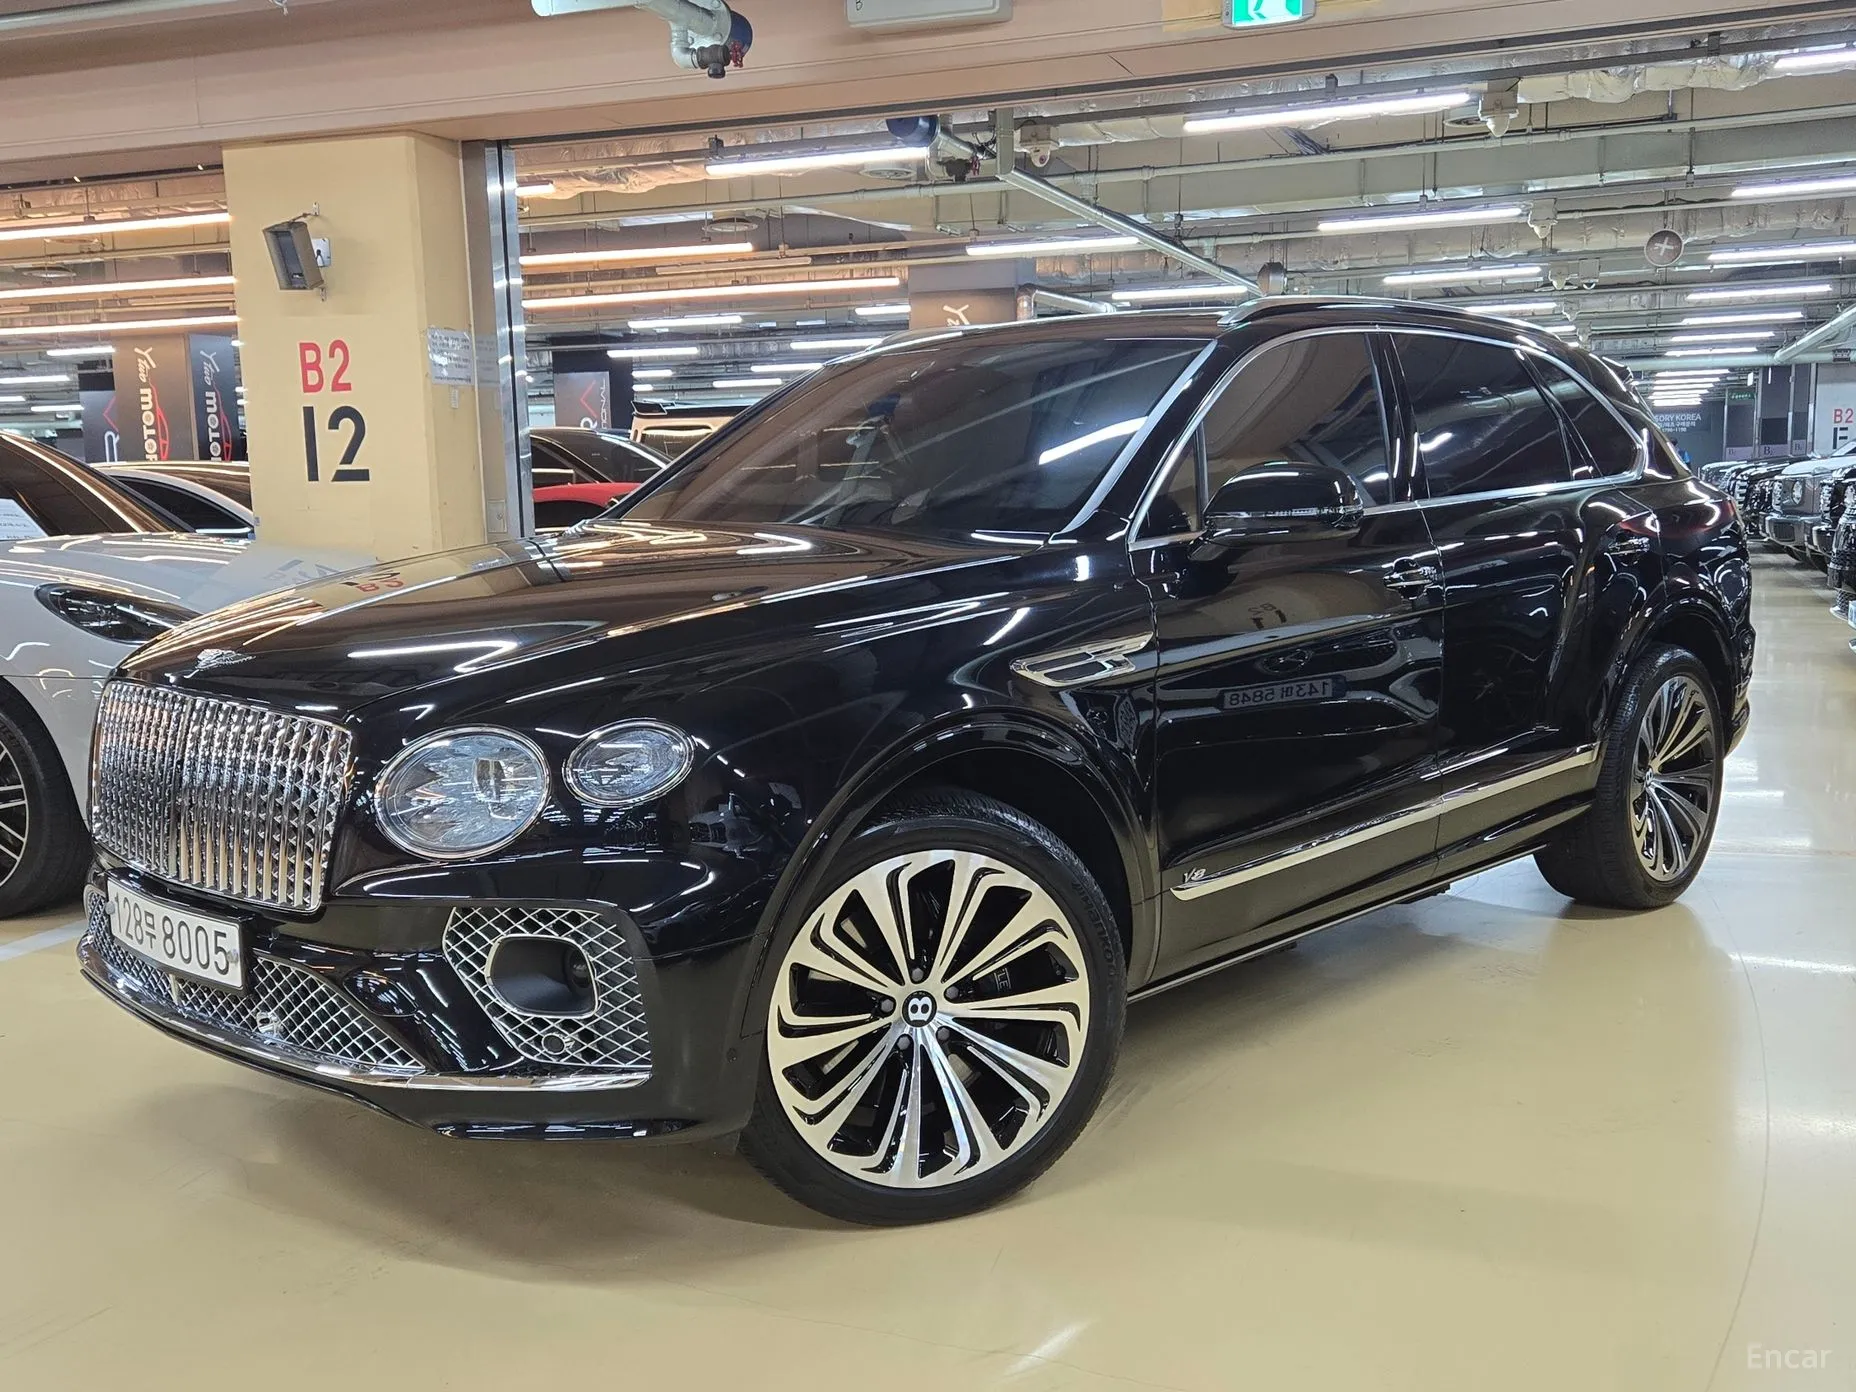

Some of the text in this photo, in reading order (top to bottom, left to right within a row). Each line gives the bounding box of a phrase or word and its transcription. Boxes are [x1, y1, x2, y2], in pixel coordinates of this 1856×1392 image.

[299, 339, 352, 393] B2
[1675, 412, 1702, 422] KOREA
[1833, 408, 1854, 424] B2
[303, 405, 370, 482] 12
[1184, 867, 1206, 883] V8
[162, 915, 230, 976] 8005
